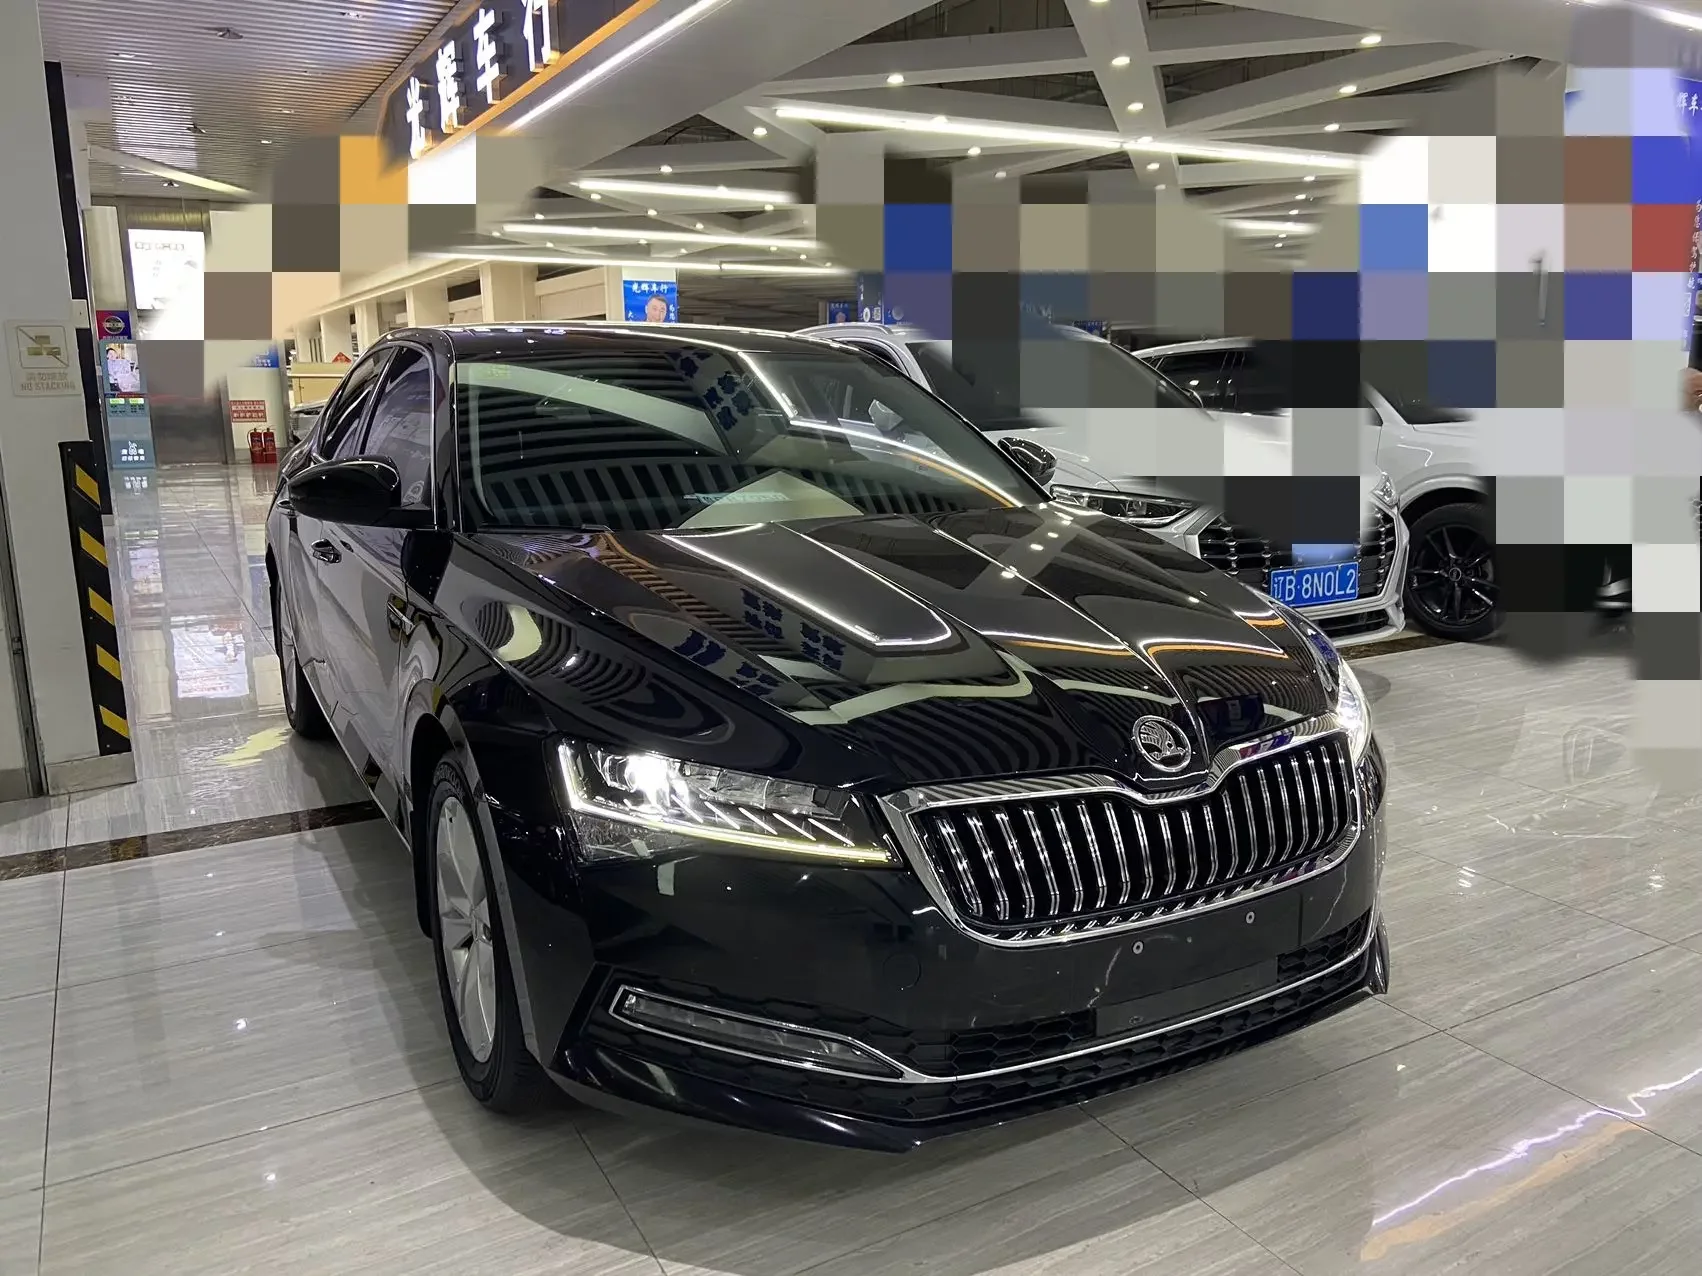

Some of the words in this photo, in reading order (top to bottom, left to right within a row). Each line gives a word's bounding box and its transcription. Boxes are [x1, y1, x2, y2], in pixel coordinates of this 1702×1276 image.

[1676, 92, 1702, 117] 辉车
[632, 282, 668, 294] 光辉车行
